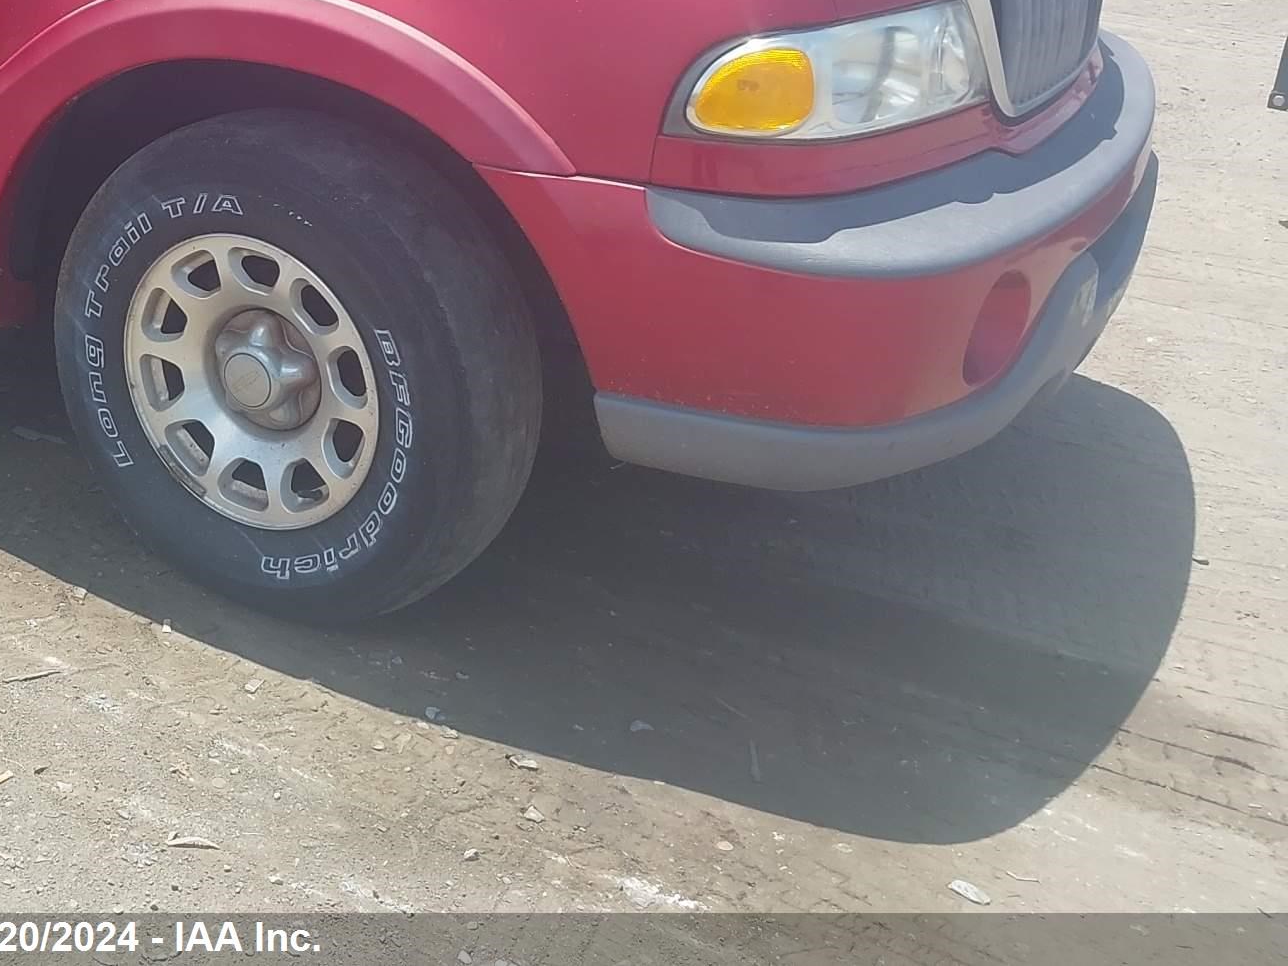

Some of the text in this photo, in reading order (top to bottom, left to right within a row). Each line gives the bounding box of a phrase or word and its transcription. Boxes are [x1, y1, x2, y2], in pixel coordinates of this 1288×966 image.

[85, 192, 244, 467] Long Trail T/A
[261, 329, 413, 580] BFGoodrich
